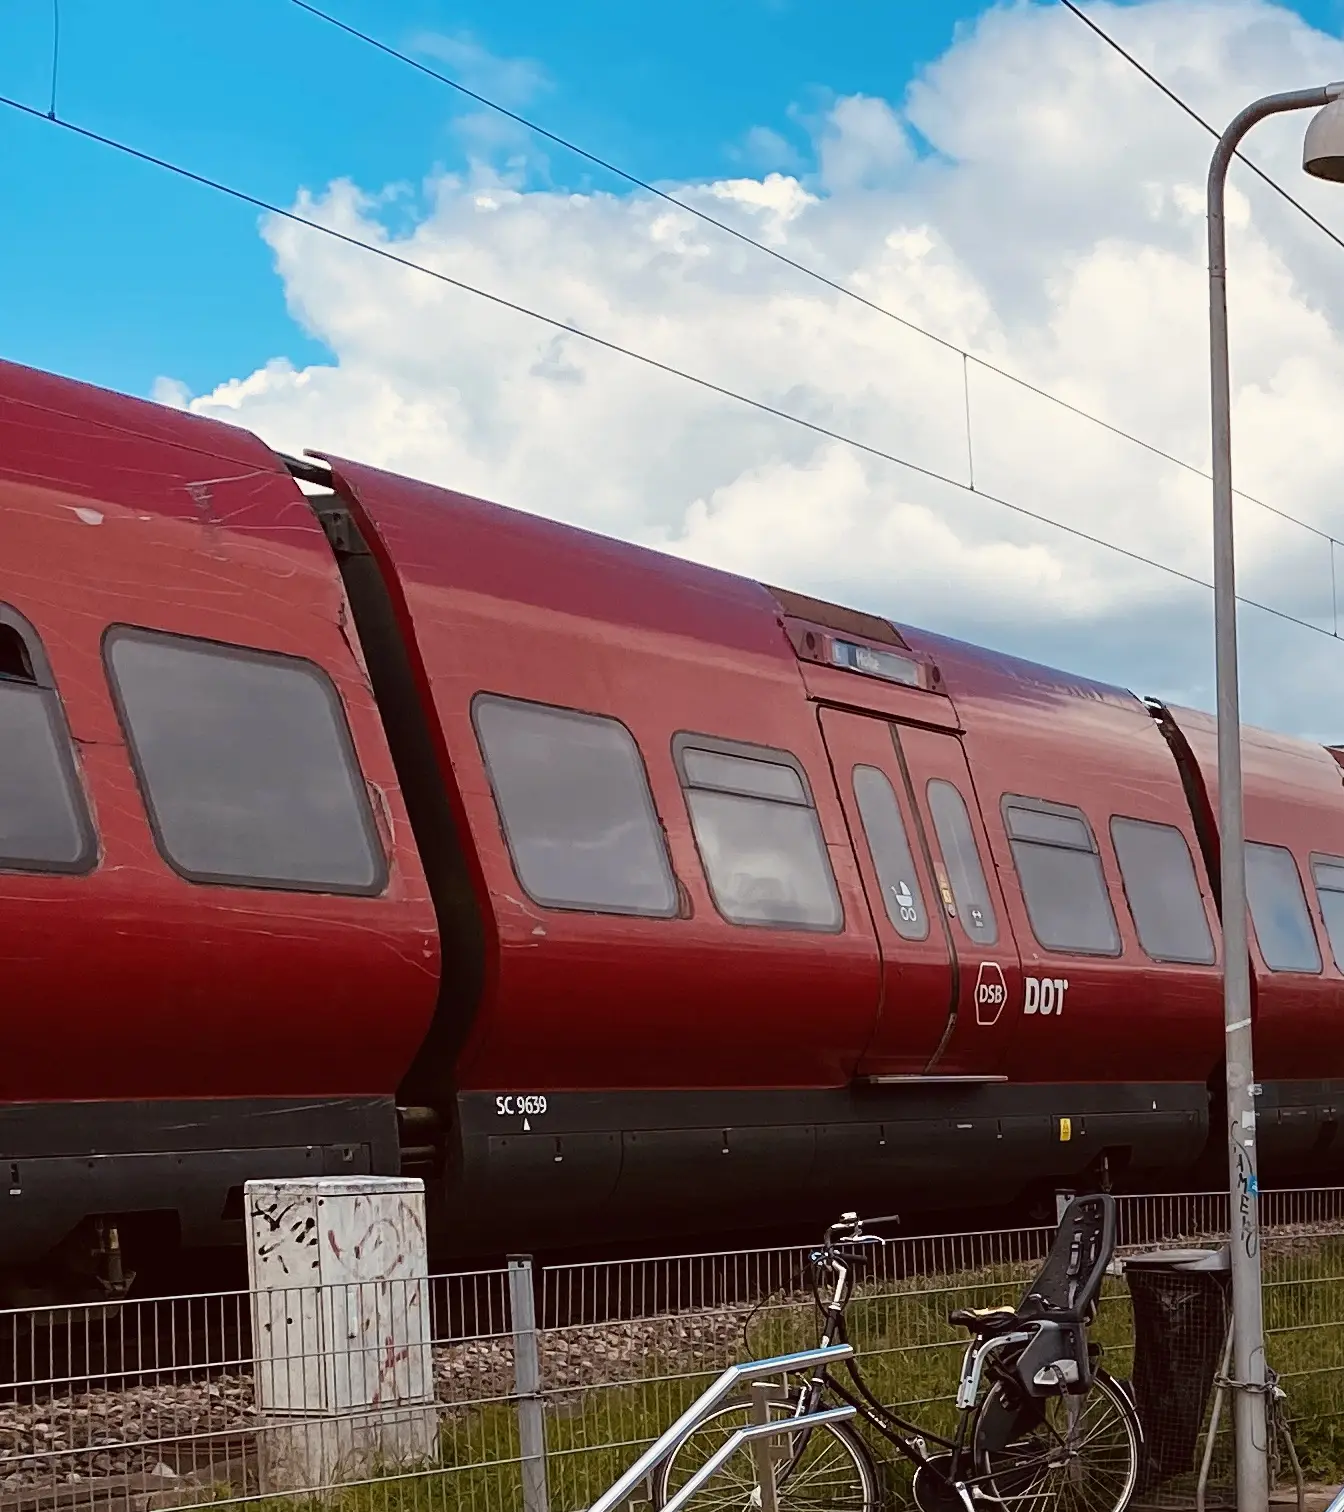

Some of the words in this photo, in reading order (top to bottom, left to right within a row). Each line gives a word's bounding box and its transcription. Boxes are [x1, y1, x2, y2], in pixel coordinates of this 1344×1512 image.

[980, 984, 1003, 1003] DSB
[1024, 977, 1069, 1015] DOT
[496, 1096, 515, 1115] SC
[516, 1095, 547, 1115] 9639
